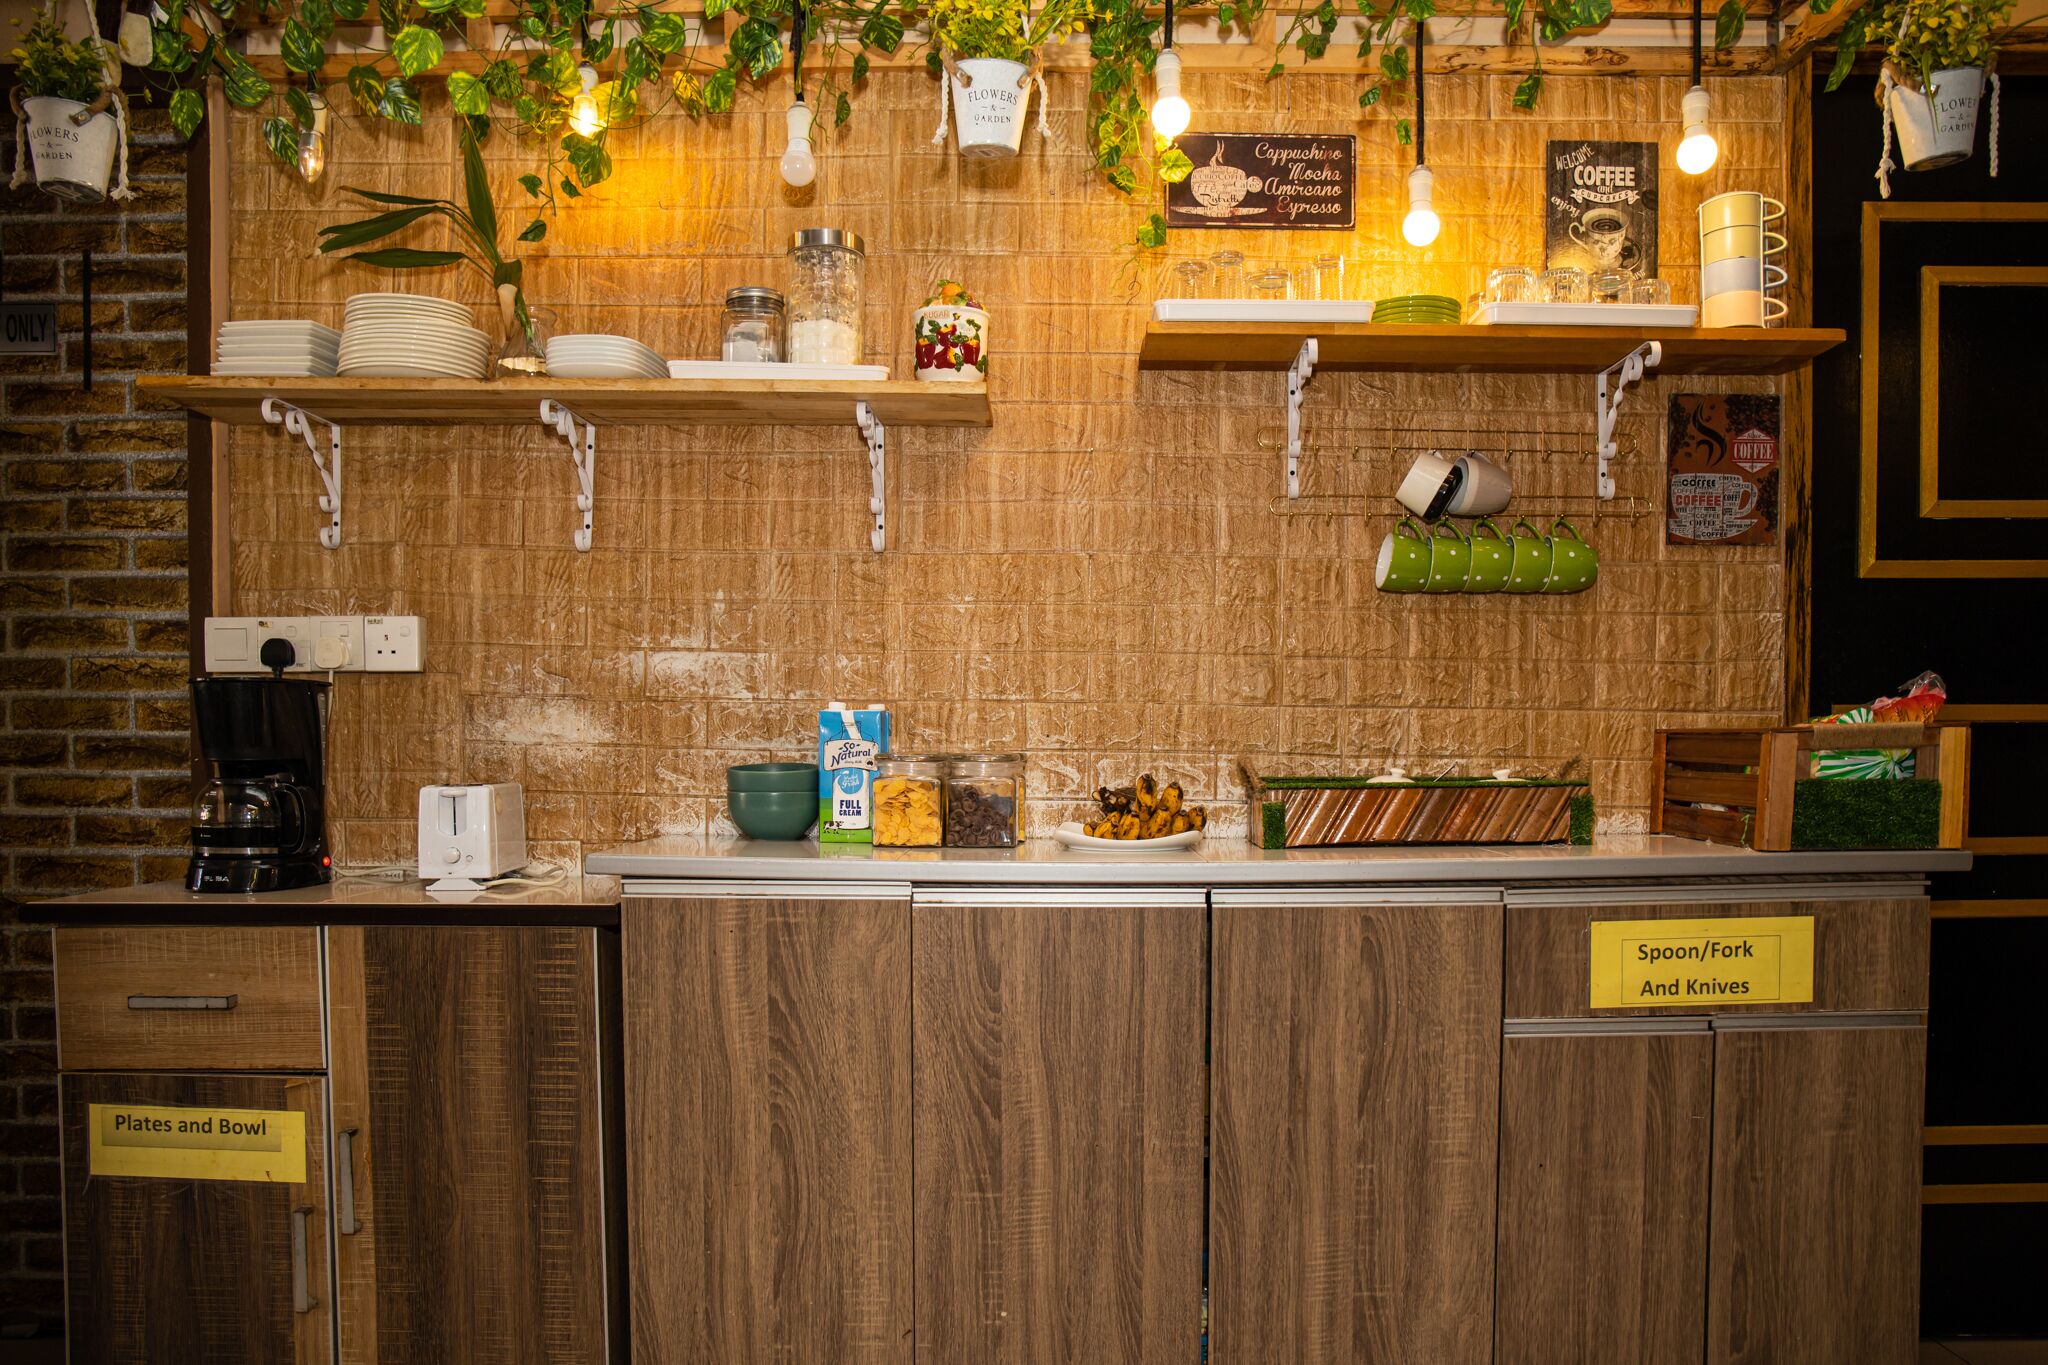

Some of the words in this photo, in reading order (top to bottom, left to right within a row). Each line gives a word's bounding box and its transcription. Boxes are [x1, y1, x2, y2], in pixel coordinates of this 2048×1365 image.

[968, 88, 1018, 106] FLOWERS
[974, 114, 1011, 124] GARDEN
[31, 126, 80, 142] LOWERS
[1255, 142, 1343, 166] Cappuchino
[1555, 143, 1595, 171] WELCOME
[1288, 162, 1342, 181] Mocha
[1573, 165, 1635, 187] COFFEE
[1264, 177, 1343, 197] Amircano
[1580, 190, 1629, 201] CUPCAKES
[1597, 181, 1614, 194] and
[1276, 196, 1343, 221] Espresso
[1551, 196, 1580, 217] enjoy
[6, 313, 48, 342] ONLY
[1734, 442, 1773, 459] COFFEE
[1681, 479, 1716, 487] COFFEE
[1675, 494, 1721, 506] COFFEE
[831, 748, 871, 767] Natural
[840, 800, 862, 809] FULL
[1638, 940, 1753, 965] Spoon/Fork
[1640, 978, 1680, 997] And
[1686, 978, 1750, 995] Knives
[115, 1114, 172, 1132] Plates
[178, 1117, 213, 1134] and
[219, 1118, 266, 1136] Bowl
